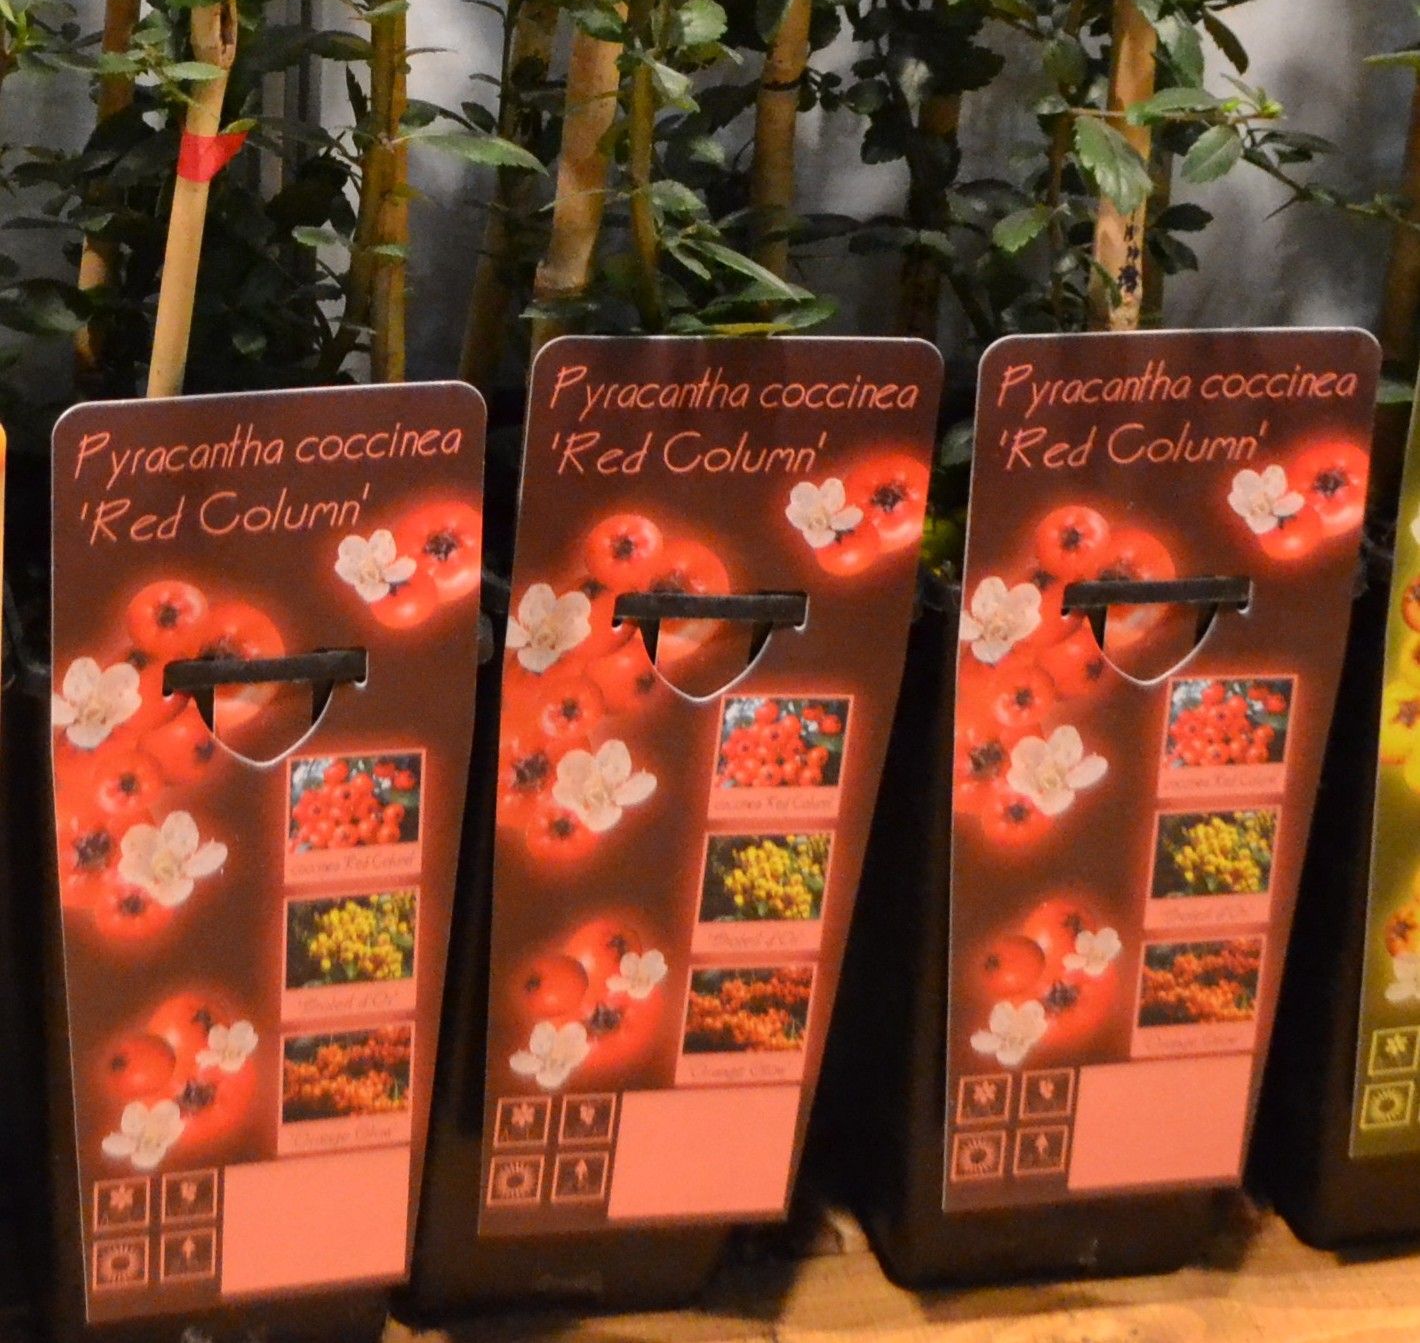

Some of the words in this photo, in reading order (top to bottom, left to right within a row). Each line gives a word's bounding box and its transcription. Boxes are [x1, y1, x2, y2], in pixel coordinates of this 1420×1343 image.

[550, 364, 750, 422] Pyracantha
[760, 374, 919, 410] coccinea
[996, 359, 1191, 419] Pyracantha
[1200, 364, 1358, 401] coccinea
[74, 423, 282, 490] Pyracantha
[295, 422, 462, 464] coccinea
[551, 432, 653, 476] 'Red
[663, 431, 828, 474] Column'
[999, 425, 1098, 471] 'Red
[1107, 420, 1269, 464] Column'
[81, 495, 186, 546] 'Red
[200, 482, 370, 536] Column'
